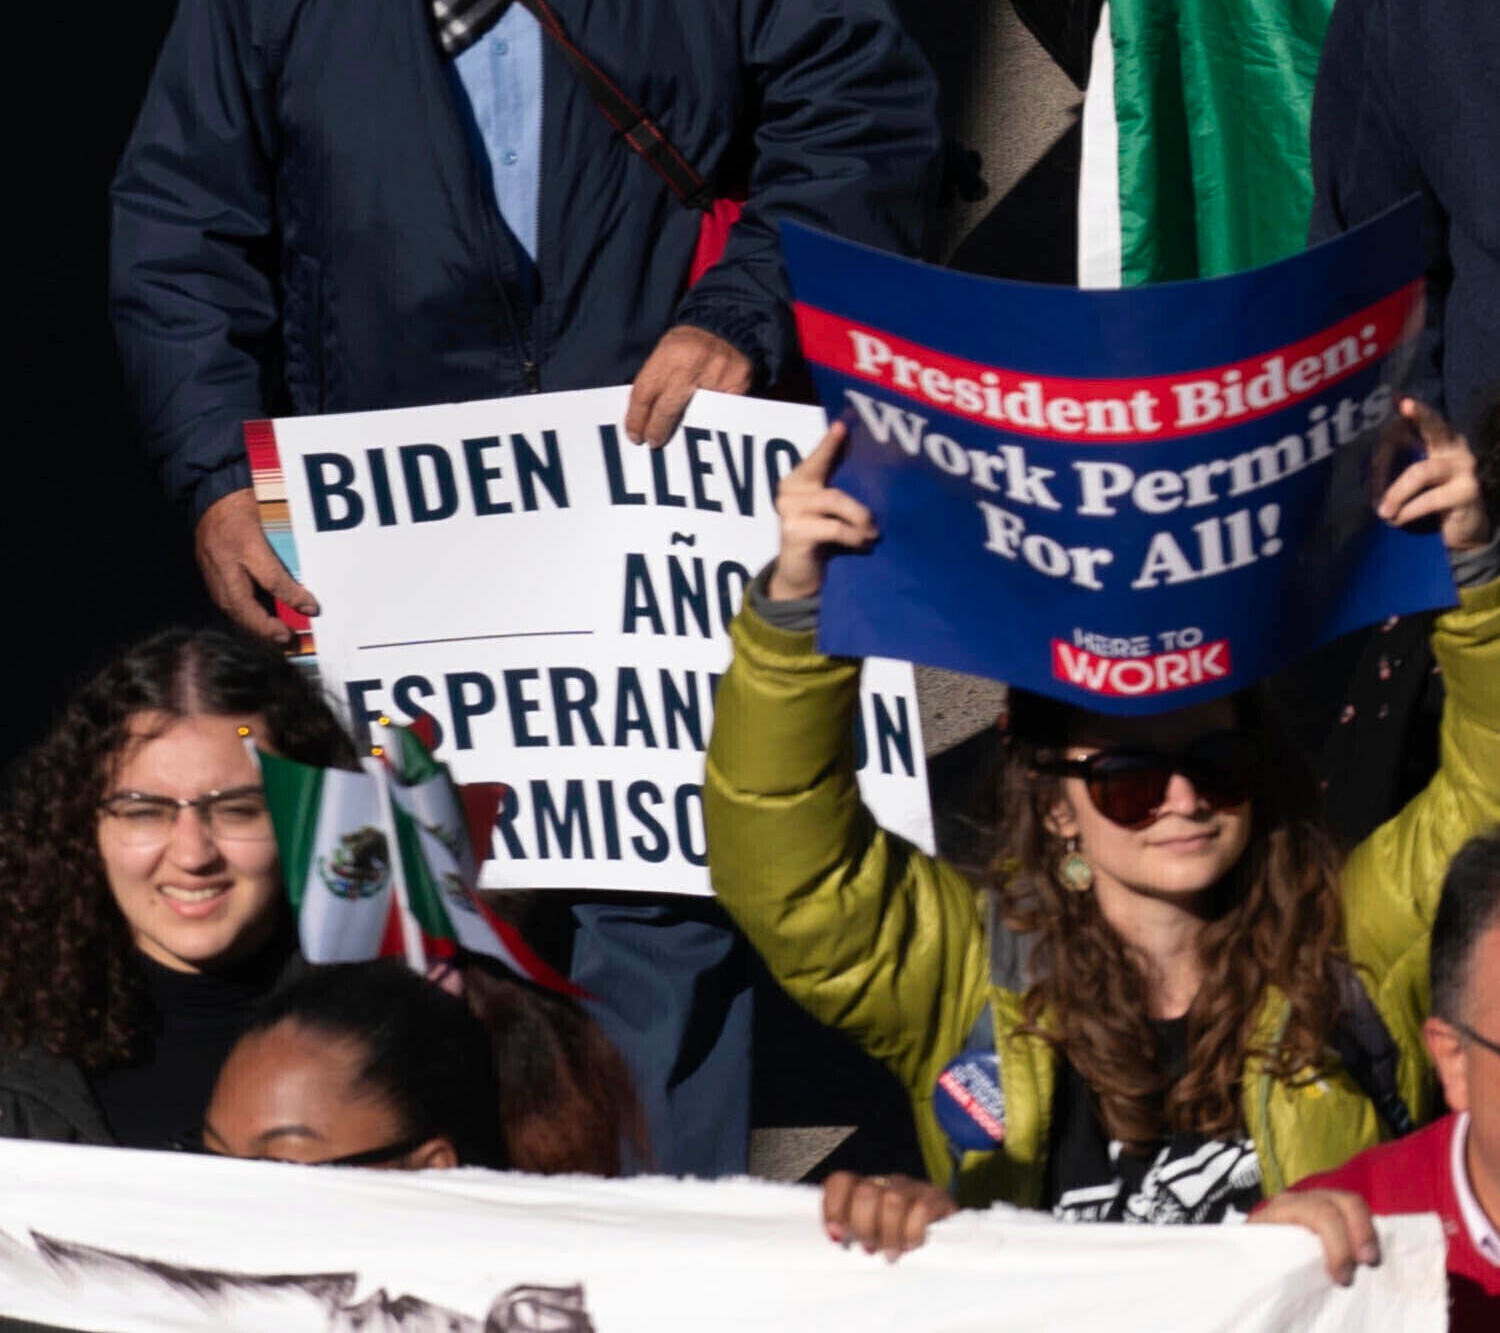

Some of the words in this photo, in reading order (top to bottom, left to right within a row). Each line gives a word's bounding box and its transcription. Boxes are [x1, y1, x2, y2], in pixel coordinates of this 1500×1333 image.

[849, 328, 1159, 437] President
[1172, 312, 1381, 427] Biden:
[304, 429, 569, 535] BIDEN
[844, 388, 1057, 512] Work
[1074, 383, 1393, 518] Permits
[979, 500, 1112, 591] For
[1130, 503, 1285, 591] All!
[1060, 644, 1228, 694] WORK
[1072, 629, 1154, 659] HERE
[1159, 628, 1205, 653] TO
